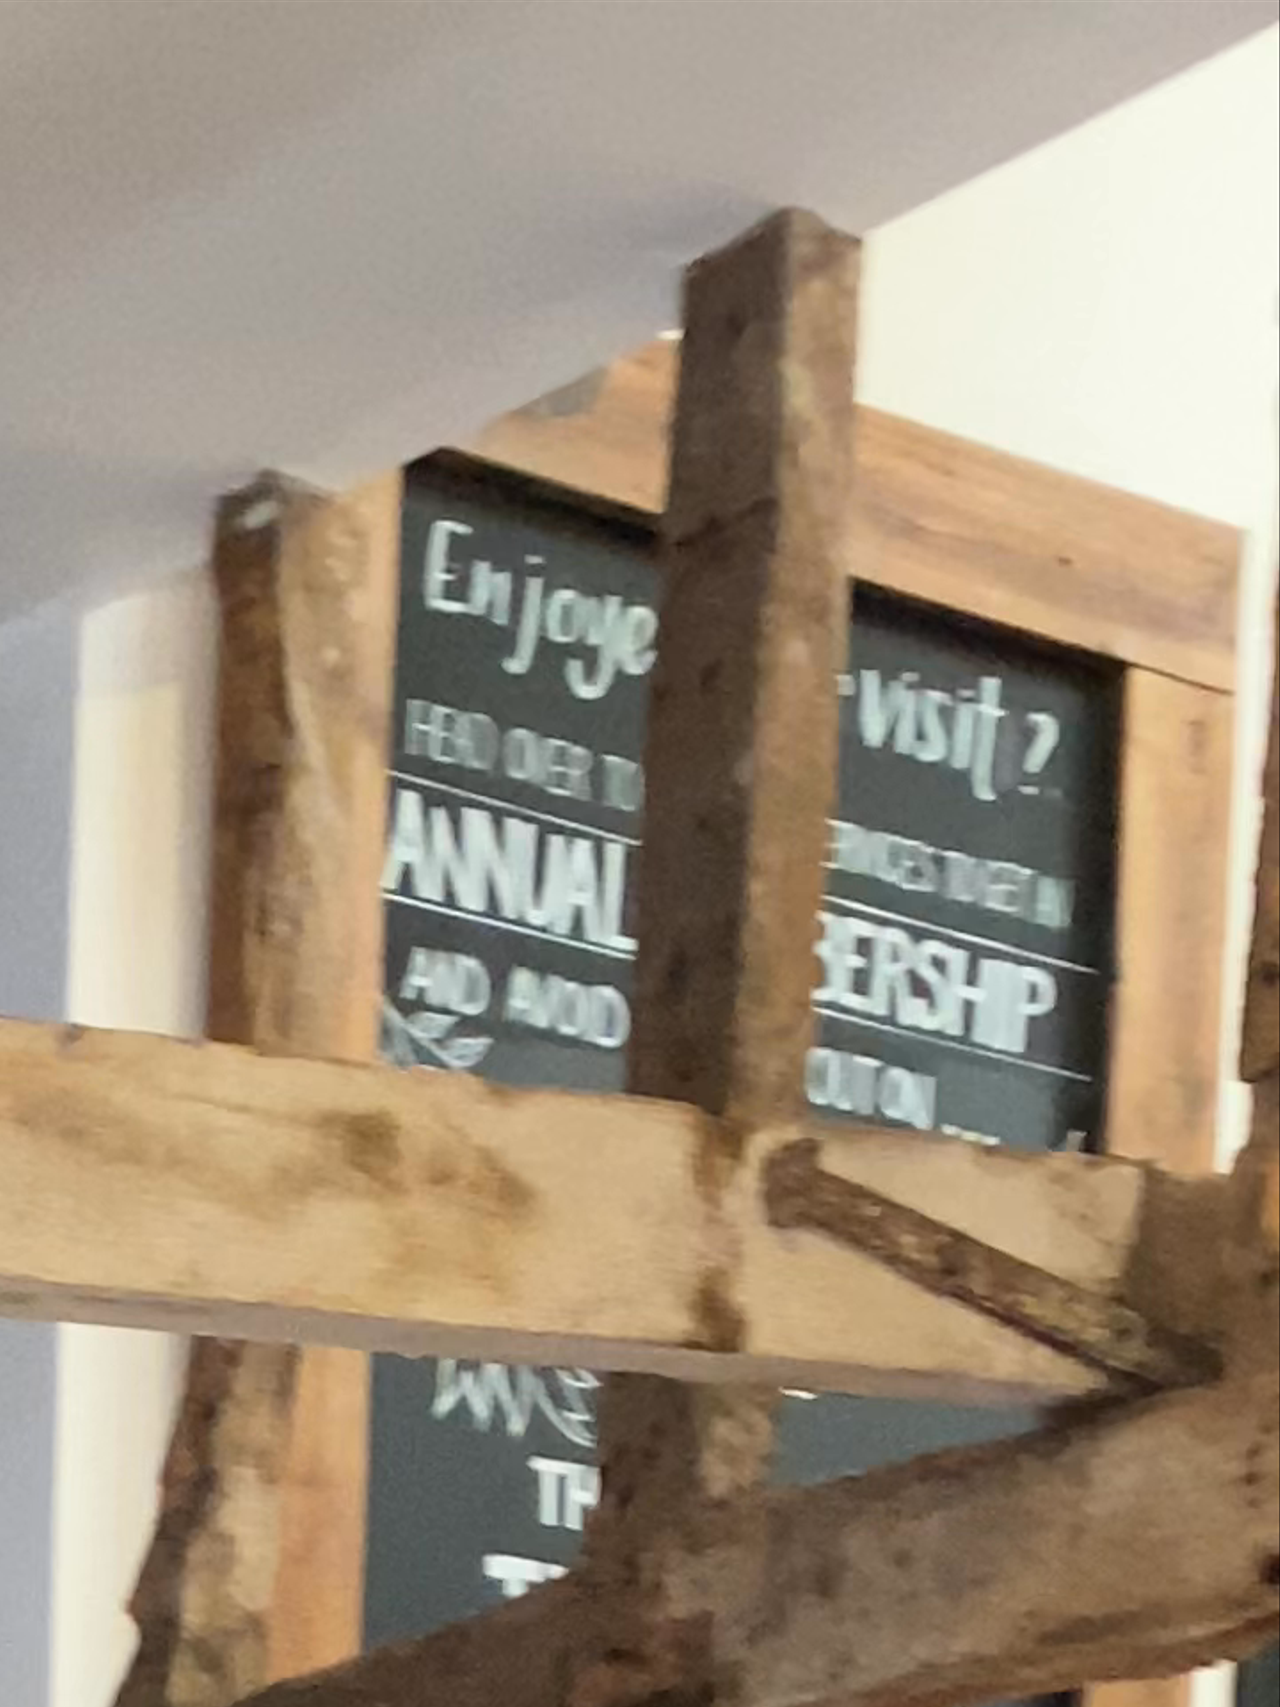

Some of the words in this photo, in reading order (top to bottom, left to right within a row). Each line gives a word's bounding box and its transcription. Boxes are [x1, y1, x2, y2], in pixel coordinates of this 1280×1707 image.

[423, 519, 659, 700] Enjoye
[380, 788, 639, 951] ANNUAL
[399, 946, 490, 1016] AND
